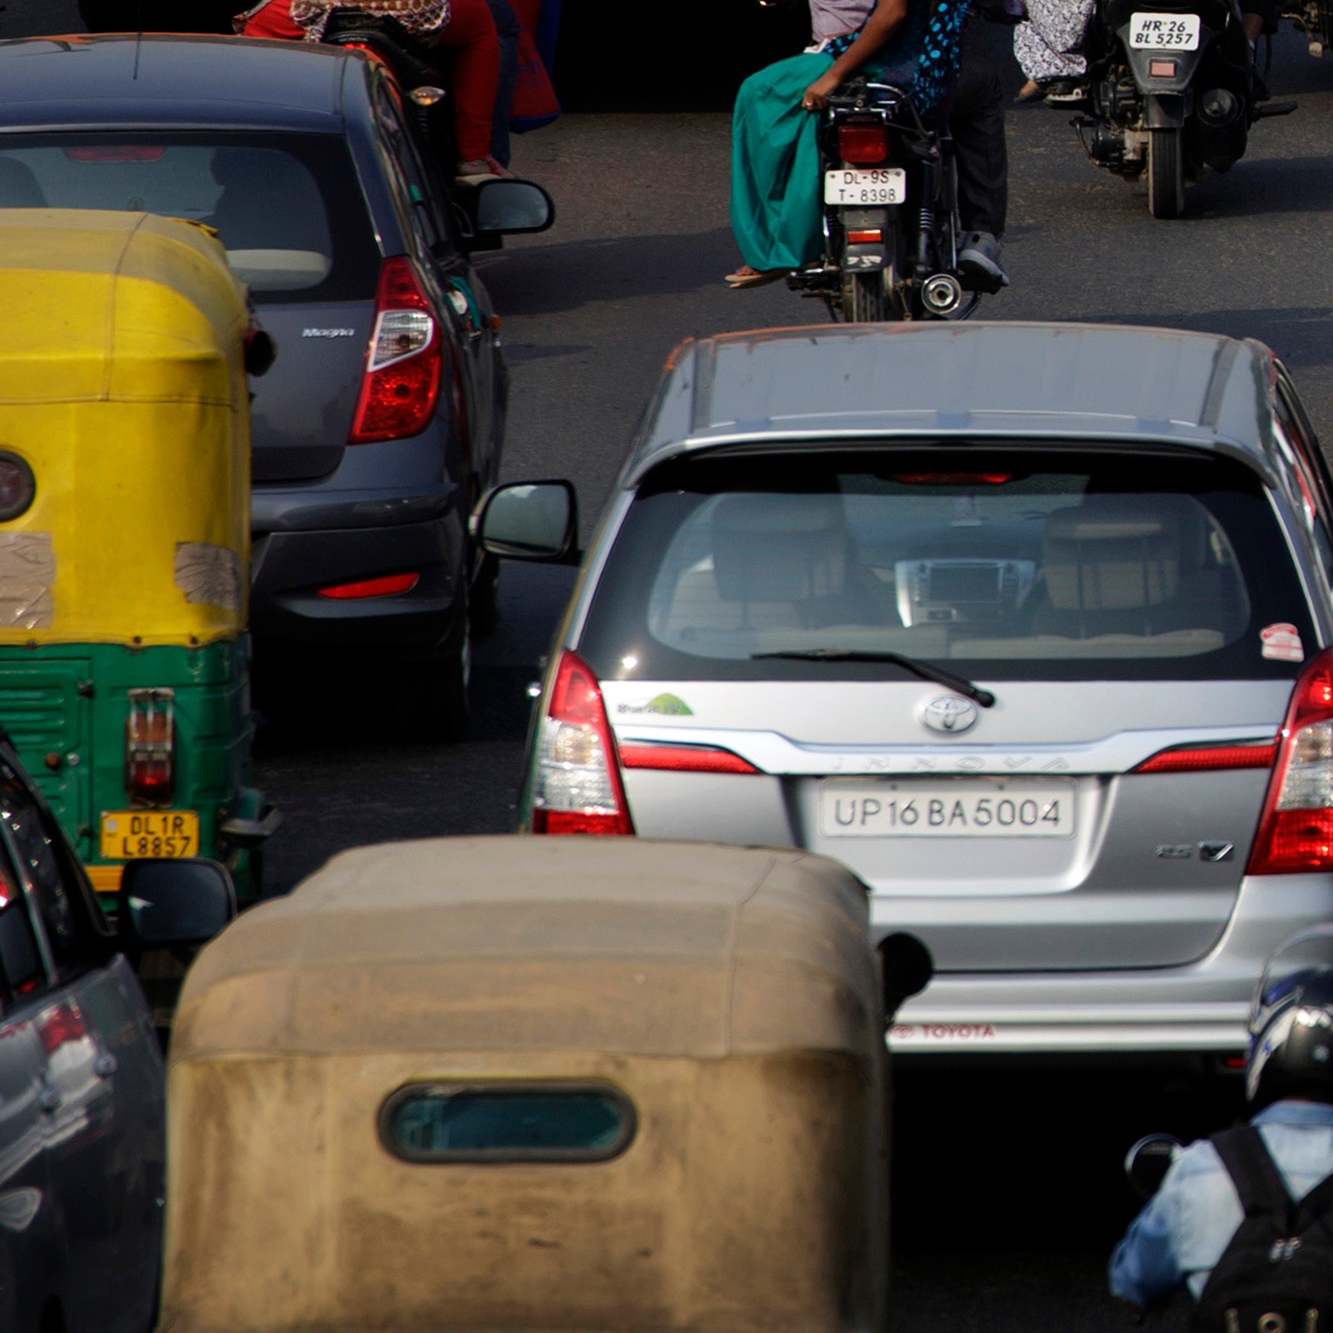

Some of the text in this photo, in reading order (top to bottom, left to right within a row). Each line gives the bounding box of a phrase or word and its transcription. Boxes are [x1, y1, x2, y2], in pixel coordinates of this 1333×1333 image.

[1141, 20, 1186, 33] HR 26
[1135, 32, 1194, 45] BL 5257
[860, 188, 897, 203] 8398
[302, 328, 355, 338] Magna
[123, 836, 192, 857] L8857
[922, 1024, 995, 1037] TOYOTA
